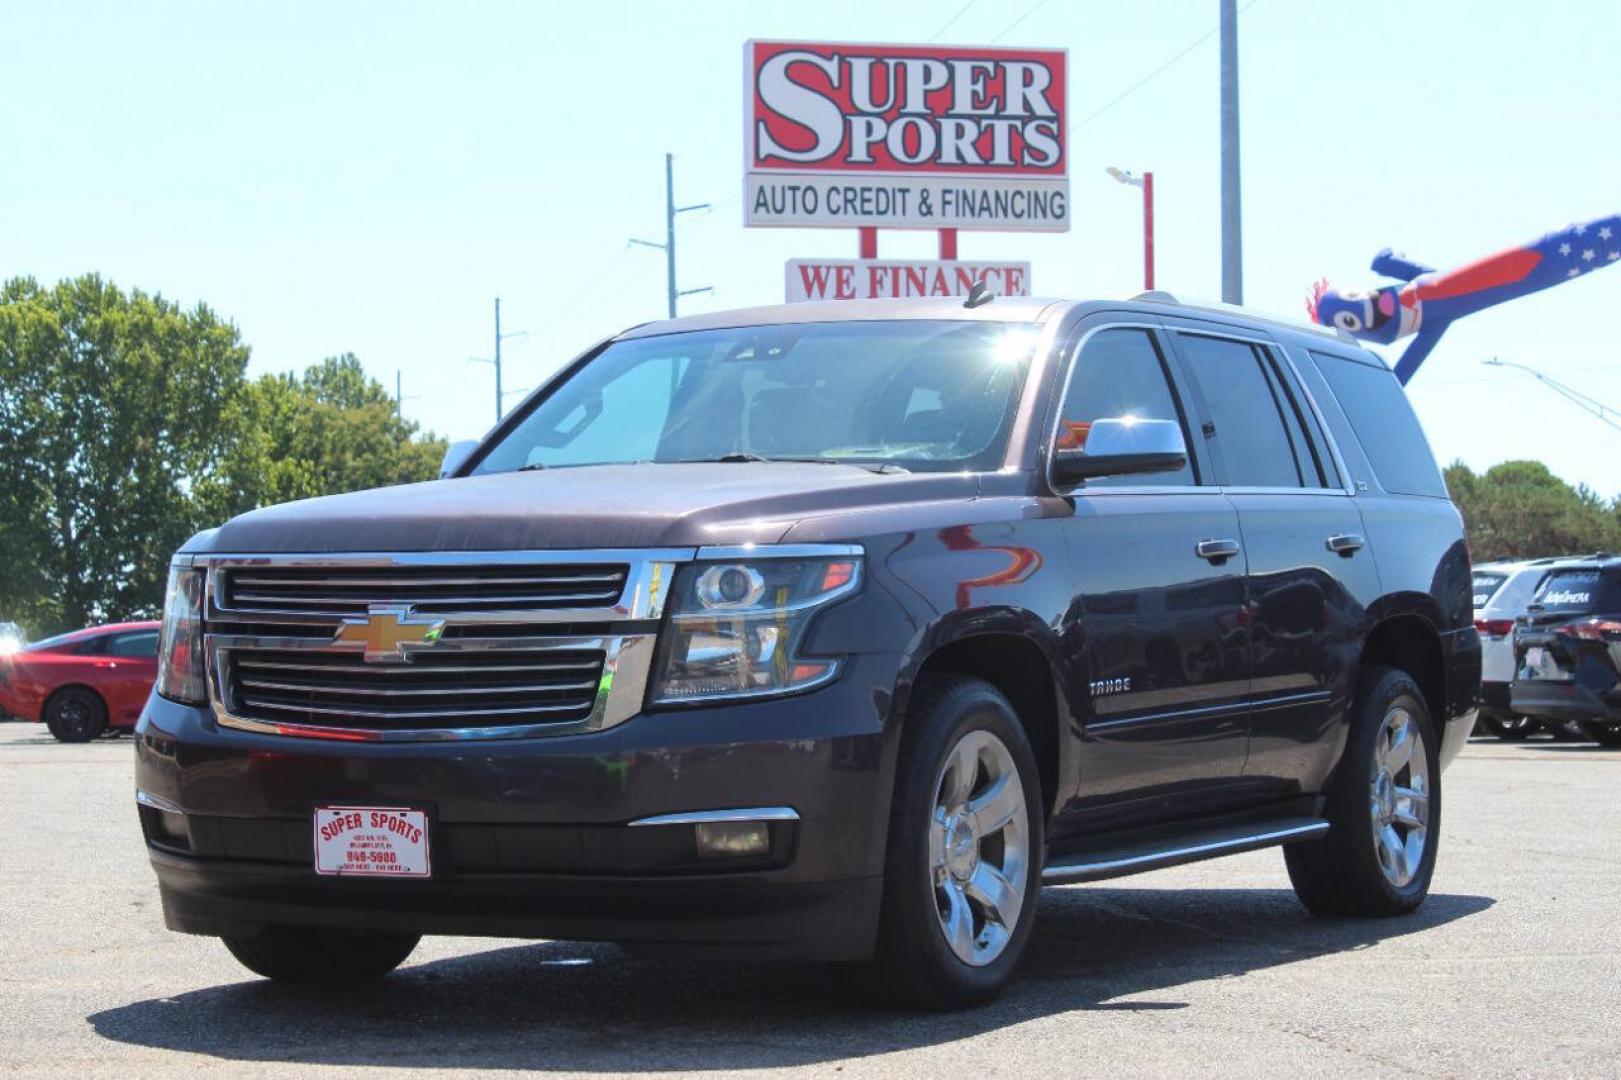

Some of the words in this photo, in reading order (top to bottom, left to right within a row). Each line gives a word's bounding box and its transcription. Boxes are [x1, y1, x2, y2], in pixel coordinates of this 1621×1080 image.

[757, 50, 1058, 163] SUPER
[754, 185, 819, 215] AUTO
[826, 186, 910, 217] CREDIT
[918, 188, 934, 217] &
[941, 188, 1066, 220] FINANCING
[798, 264, 857, 300] WE
[1089, 678, 1131, 696] TAHOE
[320, 812, 363, 842] SUPER
[370, 812, 423, 844] SPORTS
